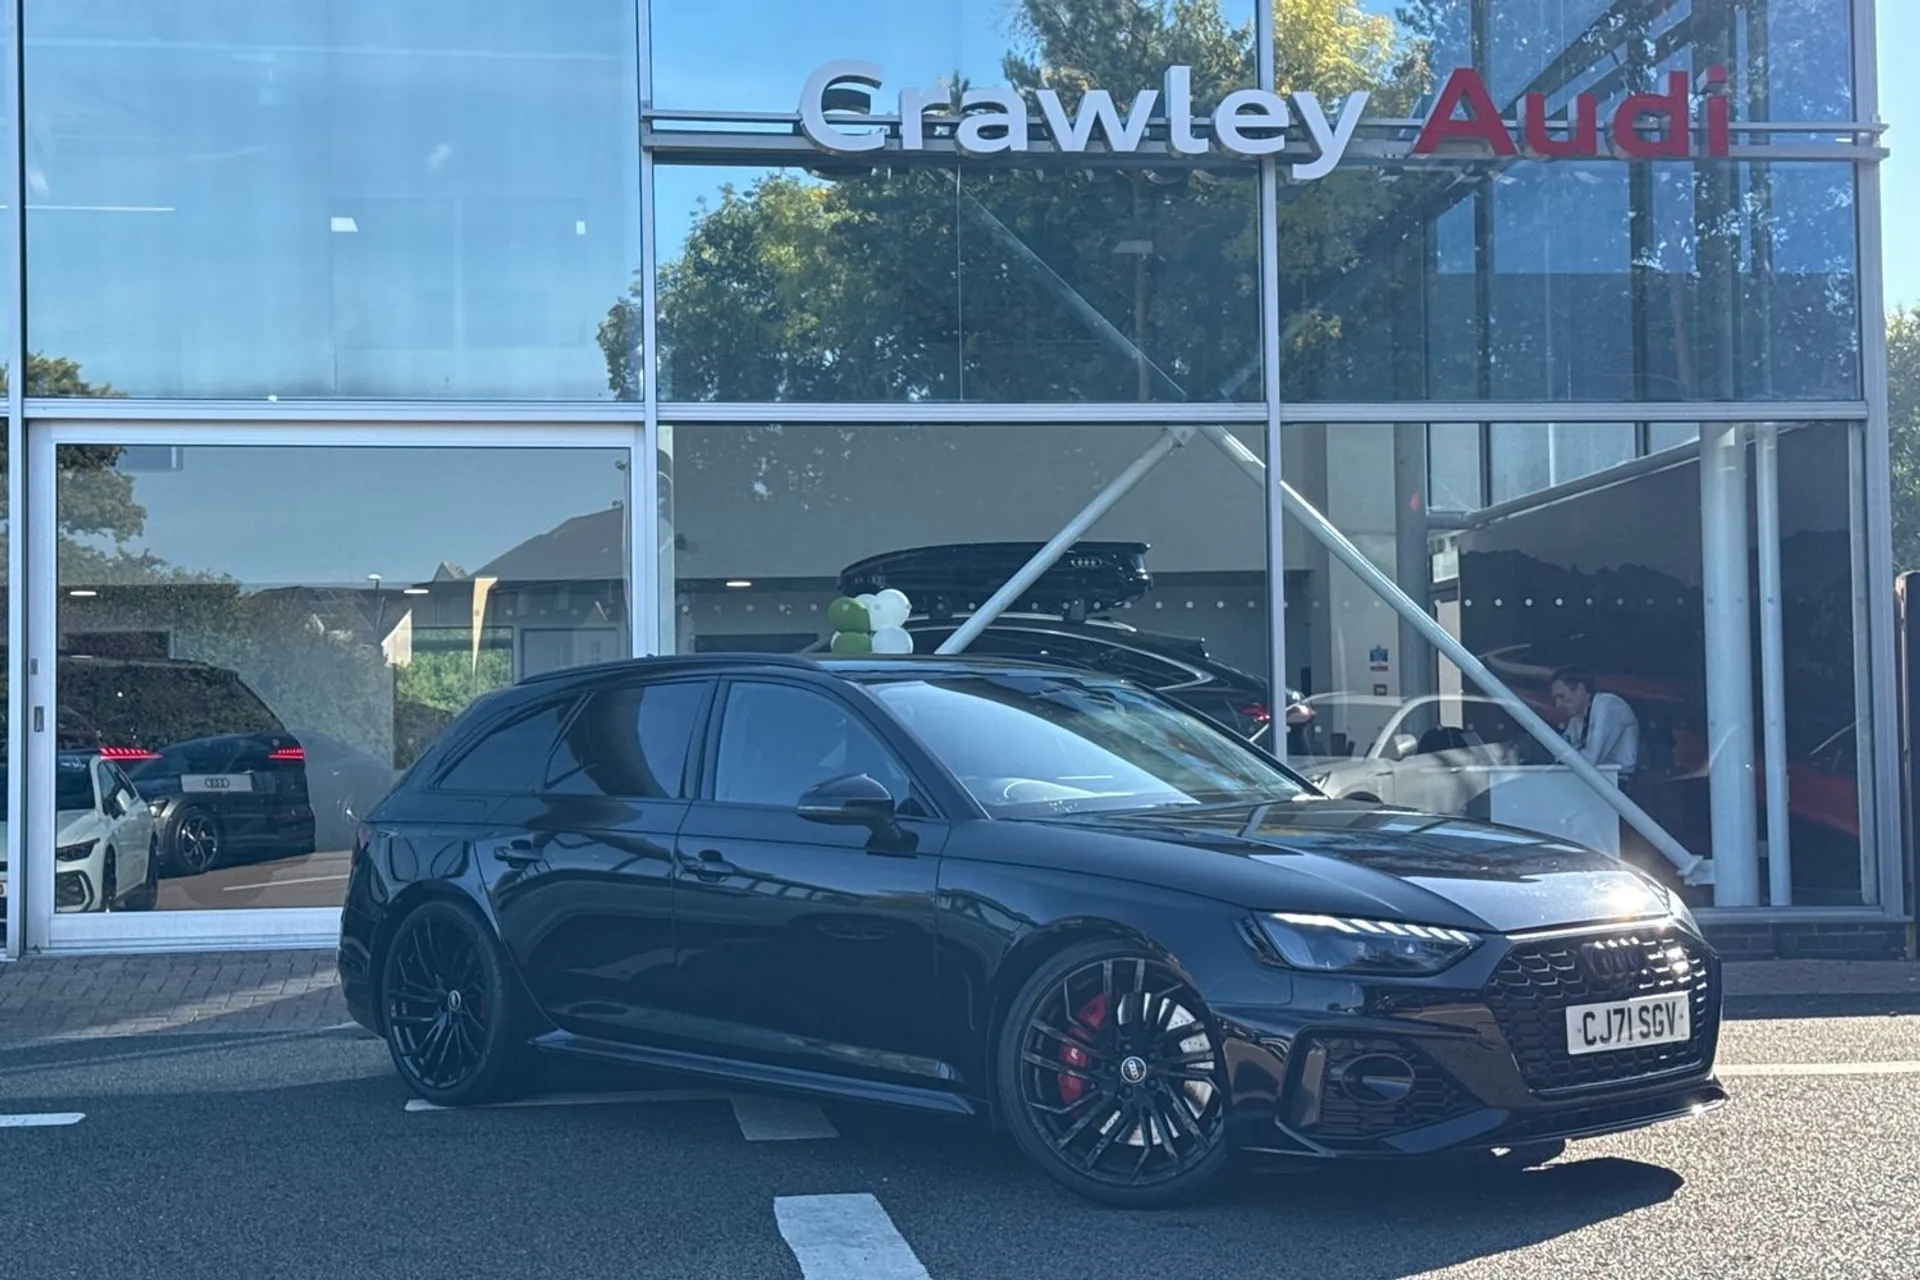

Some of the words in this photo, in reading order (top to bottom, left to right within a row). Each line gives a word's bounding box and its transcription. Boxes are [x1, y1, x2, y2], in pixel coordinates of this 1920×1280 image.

[799, 59, 1370, 180] Crawley
[1410, 66, 1729, 157] Audi
[1582, 1007, 1633, 1046] CJ71
[1638, 1001, 1676, 1039] SGV
